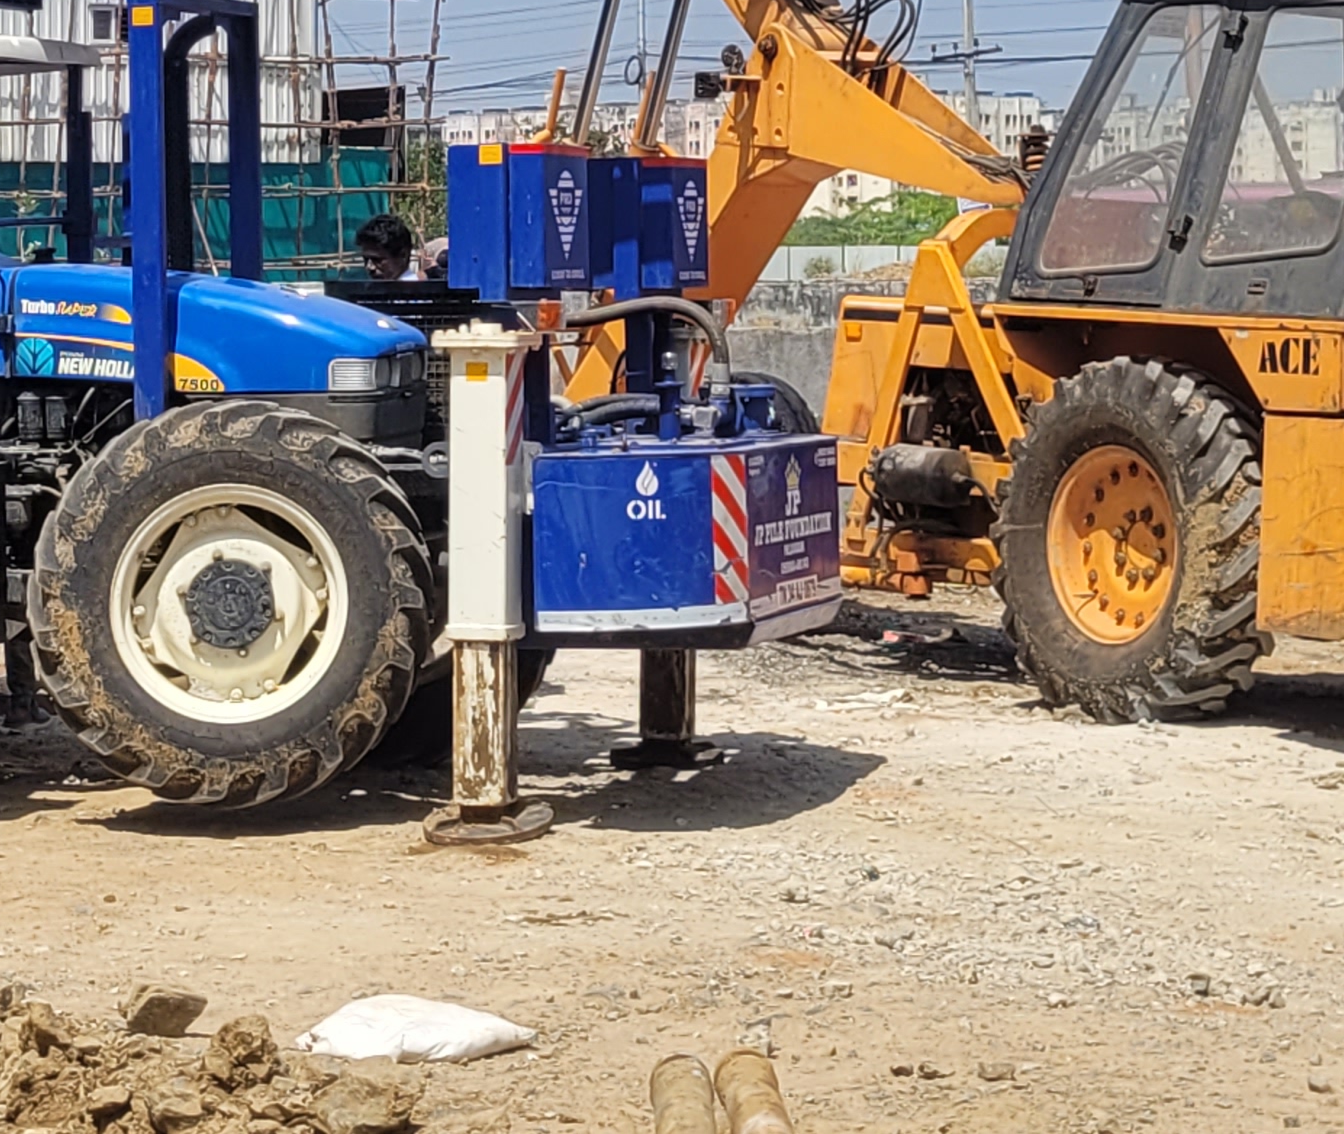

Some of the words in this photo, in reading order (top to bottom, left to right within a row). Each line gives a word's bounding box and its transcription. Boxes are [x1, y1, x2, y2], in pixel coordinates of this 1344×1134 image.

[21, 299, 56, 315] Turbo
[58, 356, 94, 375] NEW
[1258, 337, 1321, 376] ACE
[178, 378, 220, 391] 7500
[626, 499, 667, 520] OIL
[785, 489, 802, 517] JP
